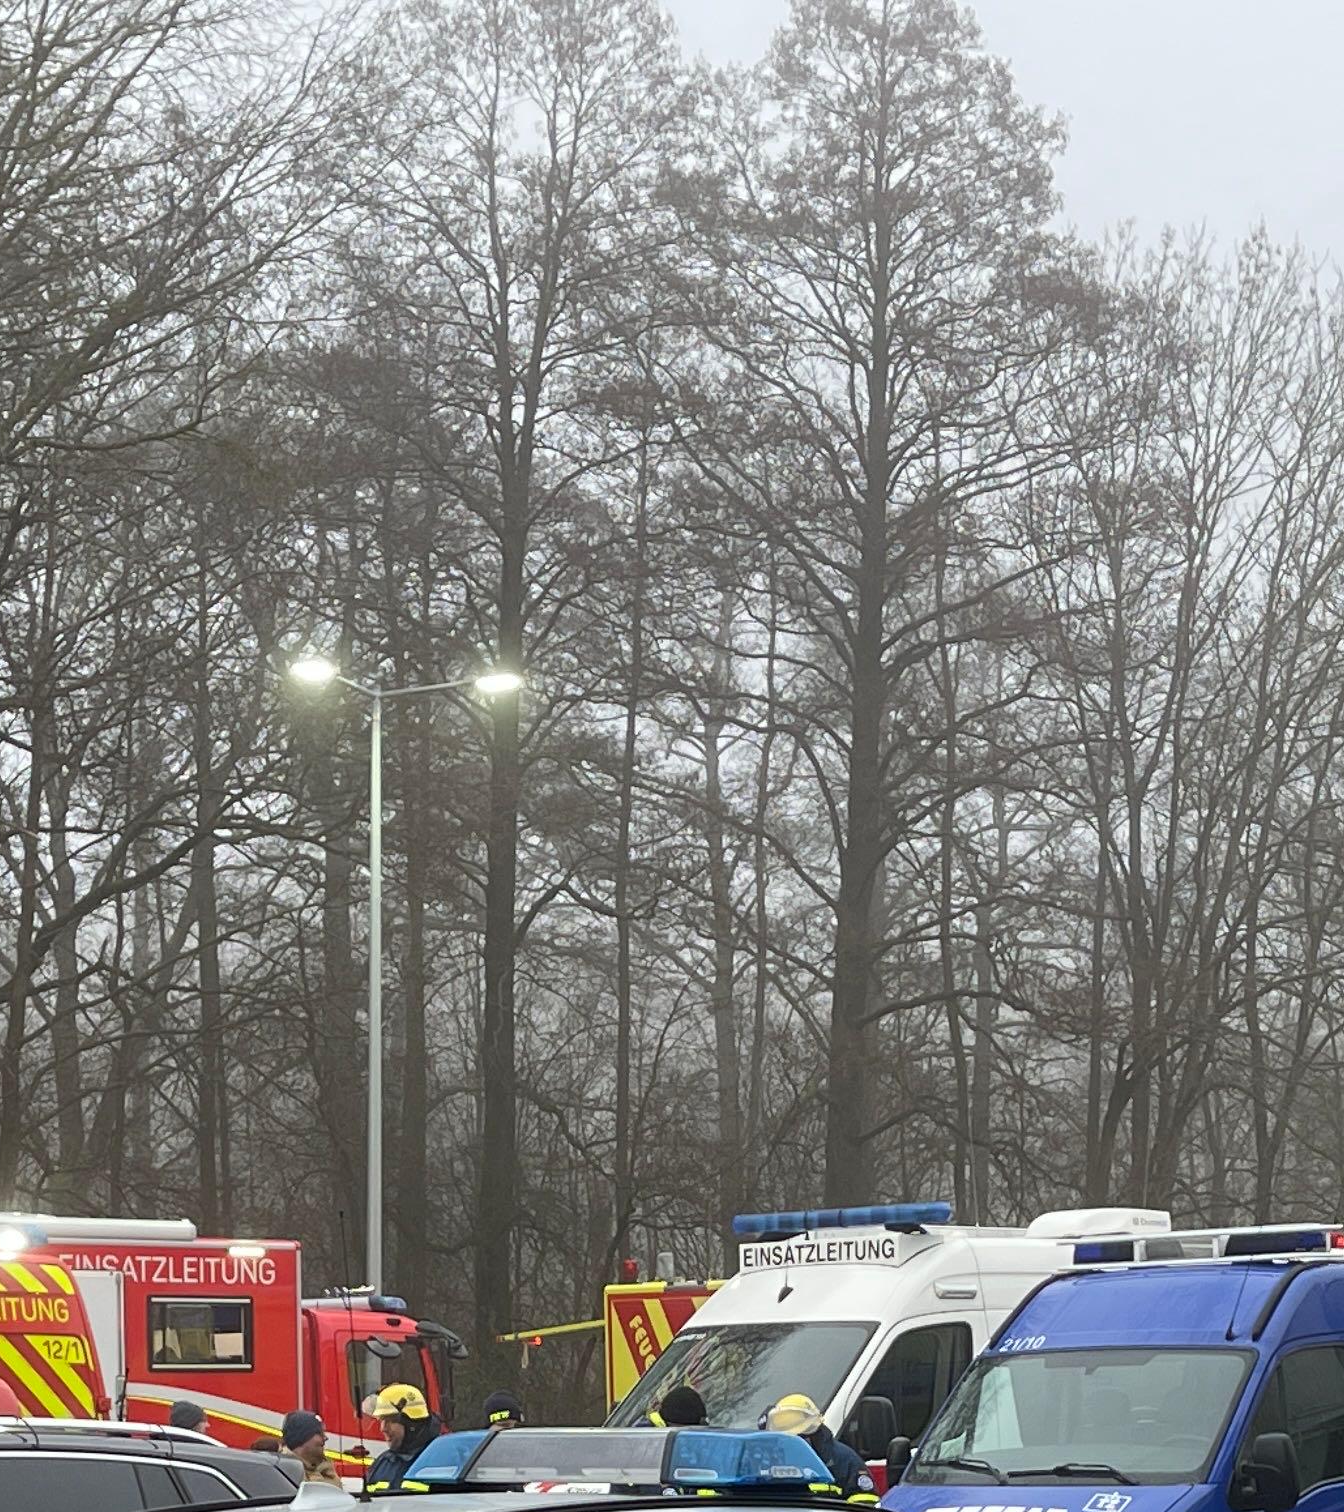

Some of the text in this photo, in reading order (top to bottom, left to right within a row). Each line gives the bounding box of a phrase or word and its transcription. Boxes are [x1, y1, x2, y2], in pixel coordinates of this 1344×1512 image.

[743, 1239, 895, 1267] EINSATZLEITUNG
[42, 1340, 81, 1361] 12/1
[999, 1335, 1046, 1352] 21/10
